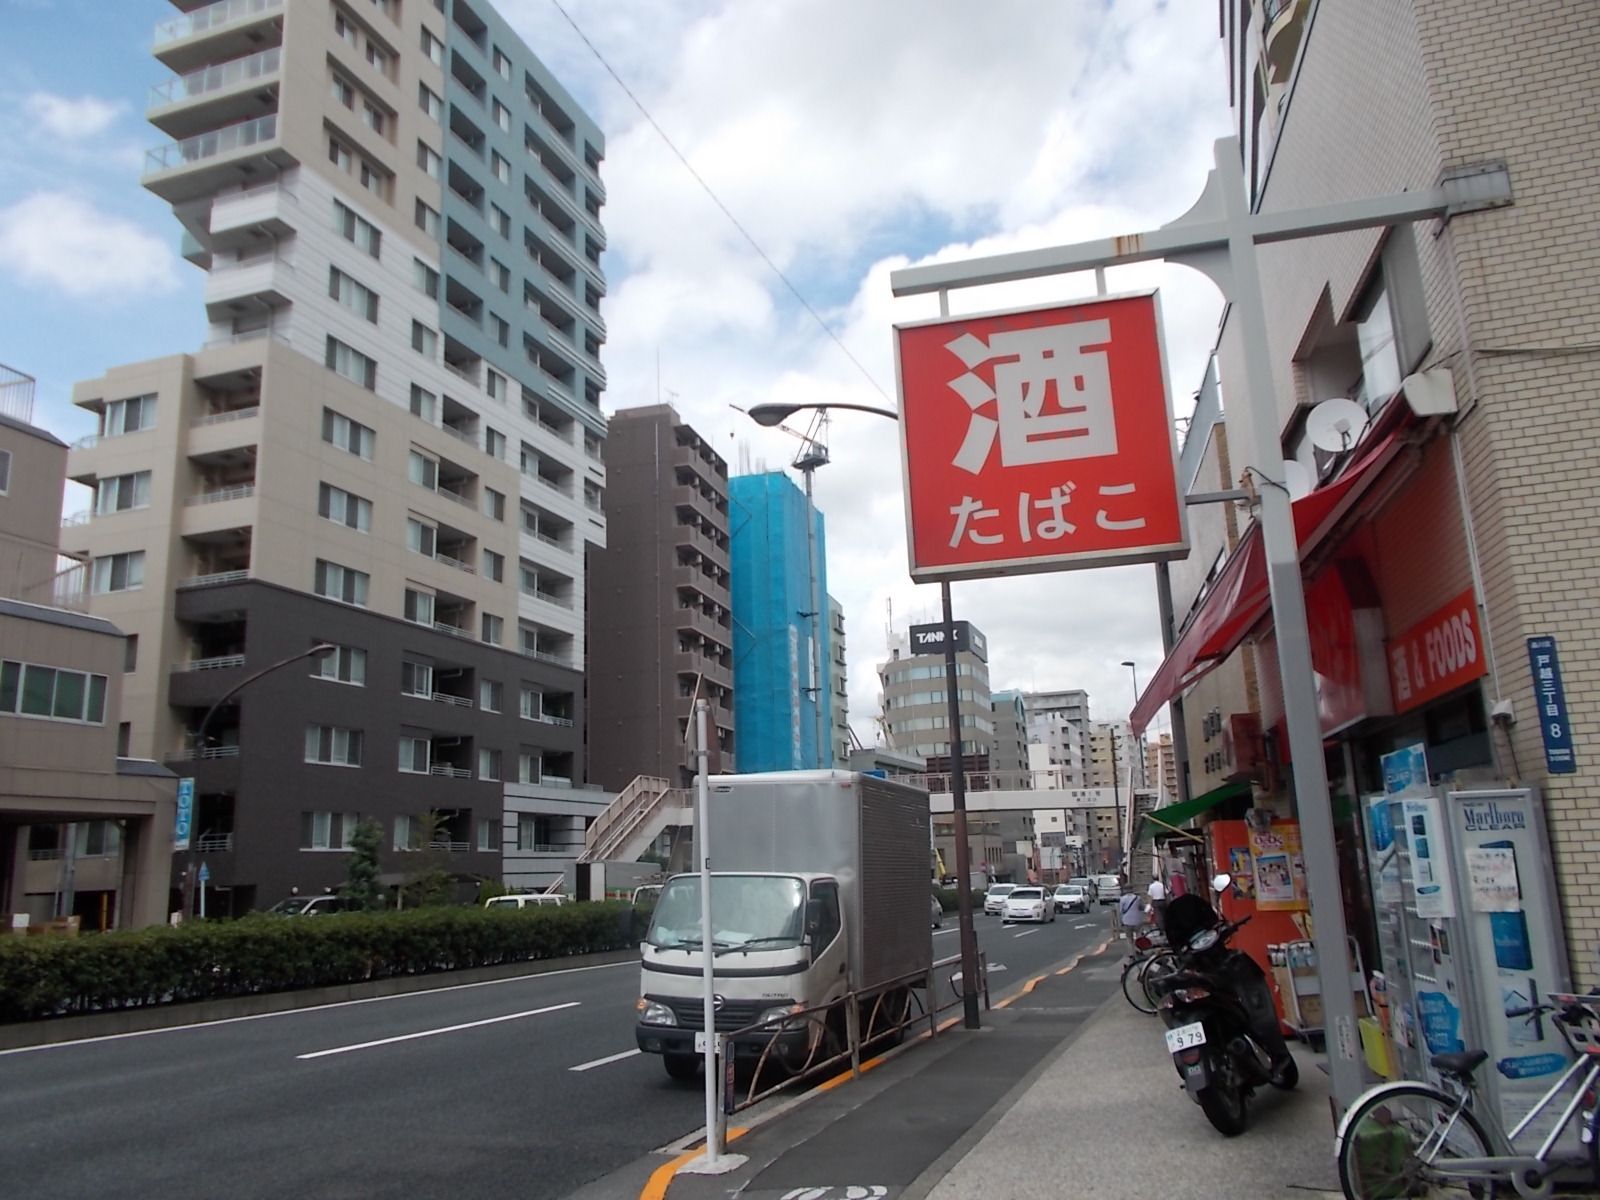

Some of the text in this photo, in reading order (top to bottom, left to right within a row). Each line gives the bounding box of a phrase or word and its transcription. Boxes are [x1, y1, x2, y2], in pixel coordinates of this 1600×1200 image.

[944, 318, 1118, 475] 酒
[949, 480, 1146, 549] たばこ
[1424, 607, 1477, 682] FOODS
[1550, 723, 1562, 738] 8
[177, 781, 192, 835] TOTO
[1464, 801, 1525, 825] Marlboro
[1465, 823, 1526, 832] CLEAR
